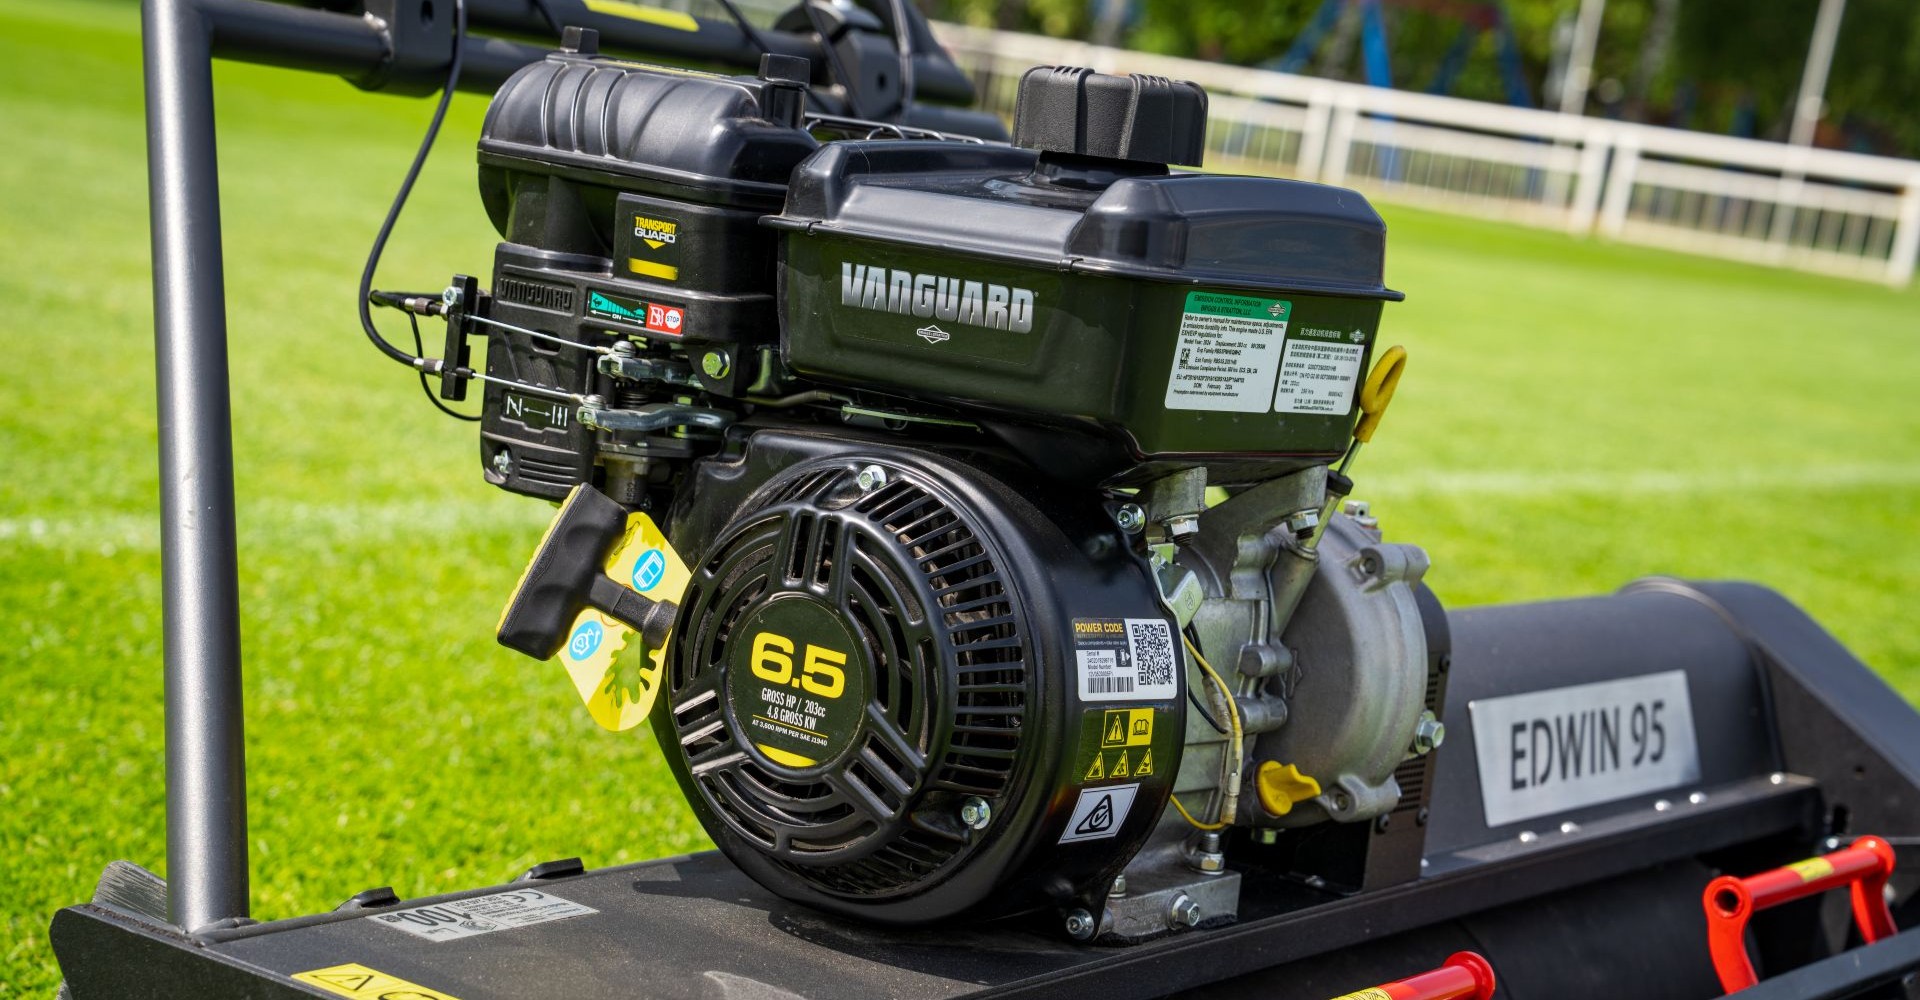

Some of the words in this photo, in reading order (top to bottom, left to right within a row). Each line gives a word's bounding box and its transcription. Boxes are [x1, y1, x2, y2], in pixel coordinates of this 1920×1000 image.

[634, 227, 676, 244] GUARD
[635, 216, 677, 234] TRANSPORT
[499, 277, 573, 311] VANGUARD
[841, 262, 1034, 334] VANGUARD
[1075, 623, 1102, 632] POWER
[1104, 623, 1123, 632] CODE
[751, 632, 847, 699] 6.5
[761, 687, 785, 706] GROSS
[786, 694, 797, 709] HP
[796, 697, 802, 713] /
[804, 700, 826, 718] 203cc
[759, 721, 775, 731] 3,600
[775, 725, 788, 735] RPM
[788, 728, 799, 738] PER
[800, 732, 811, 742] SAE
[767, 705, 779, 720] 4.8
[780, 709, 803, 727] GROSS
[804, 715, 817, 731] KW
[1511, 706, 1621, 791] EDWIN
[1630, 700, 1666, 767] 95
